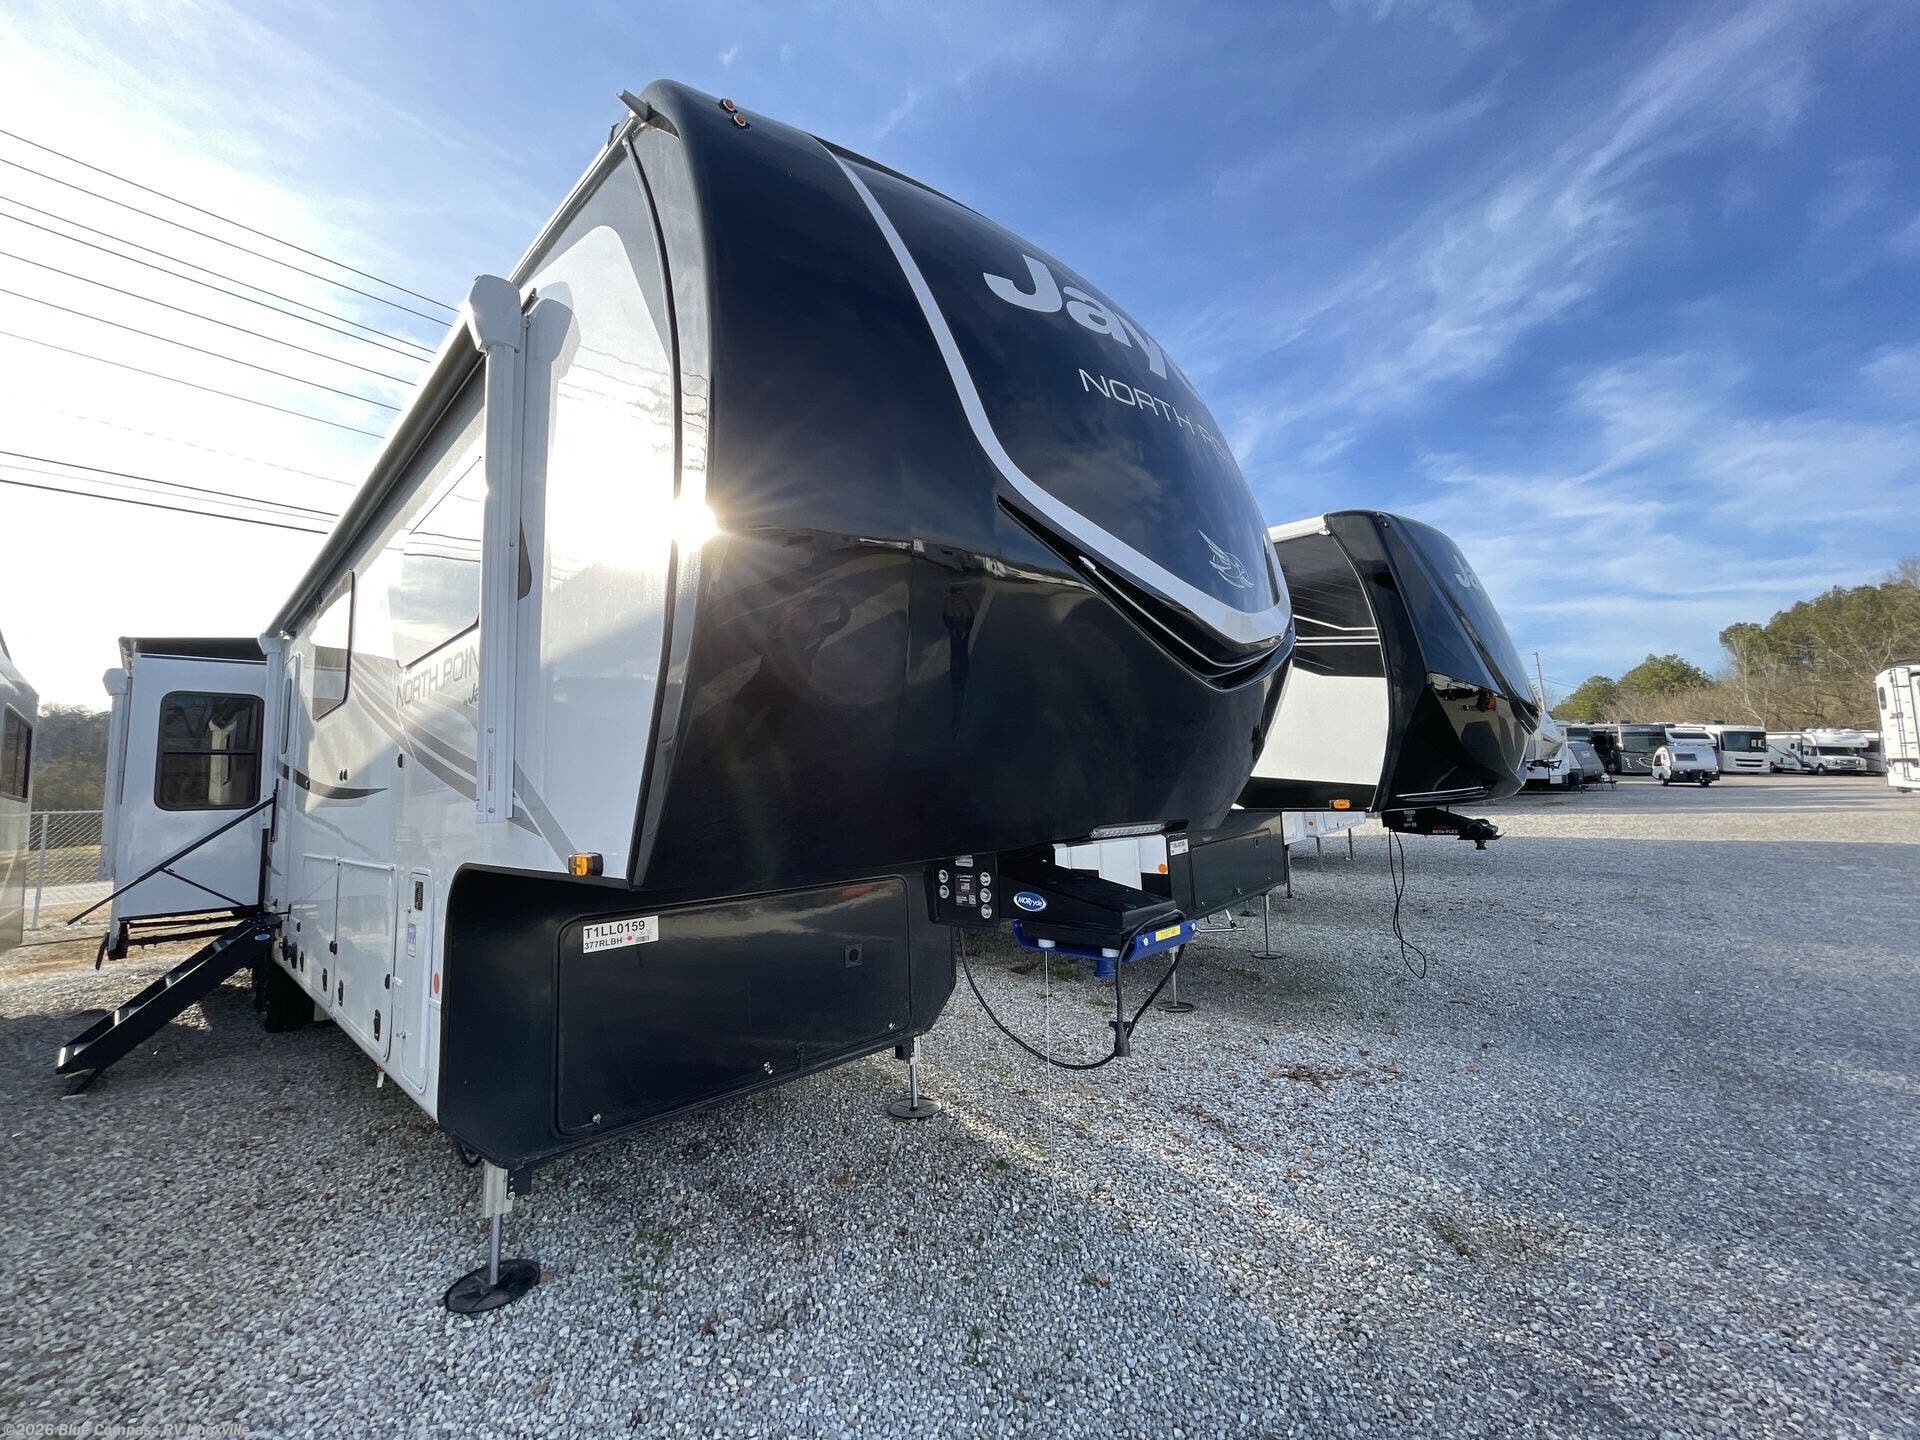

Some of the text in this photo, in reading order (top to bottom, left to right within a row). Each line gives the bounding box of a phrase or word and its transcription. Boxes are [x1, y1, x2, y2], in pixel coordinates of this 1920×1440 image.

[983, 254, 1193, 392] Jay
[1078, 368, 1195, 436] NORTH
[396, 663, 438, 709] NORTH
[584, 920, 645, 939] T1LL0159
[584, 936, 623, 950] 377RLBH
